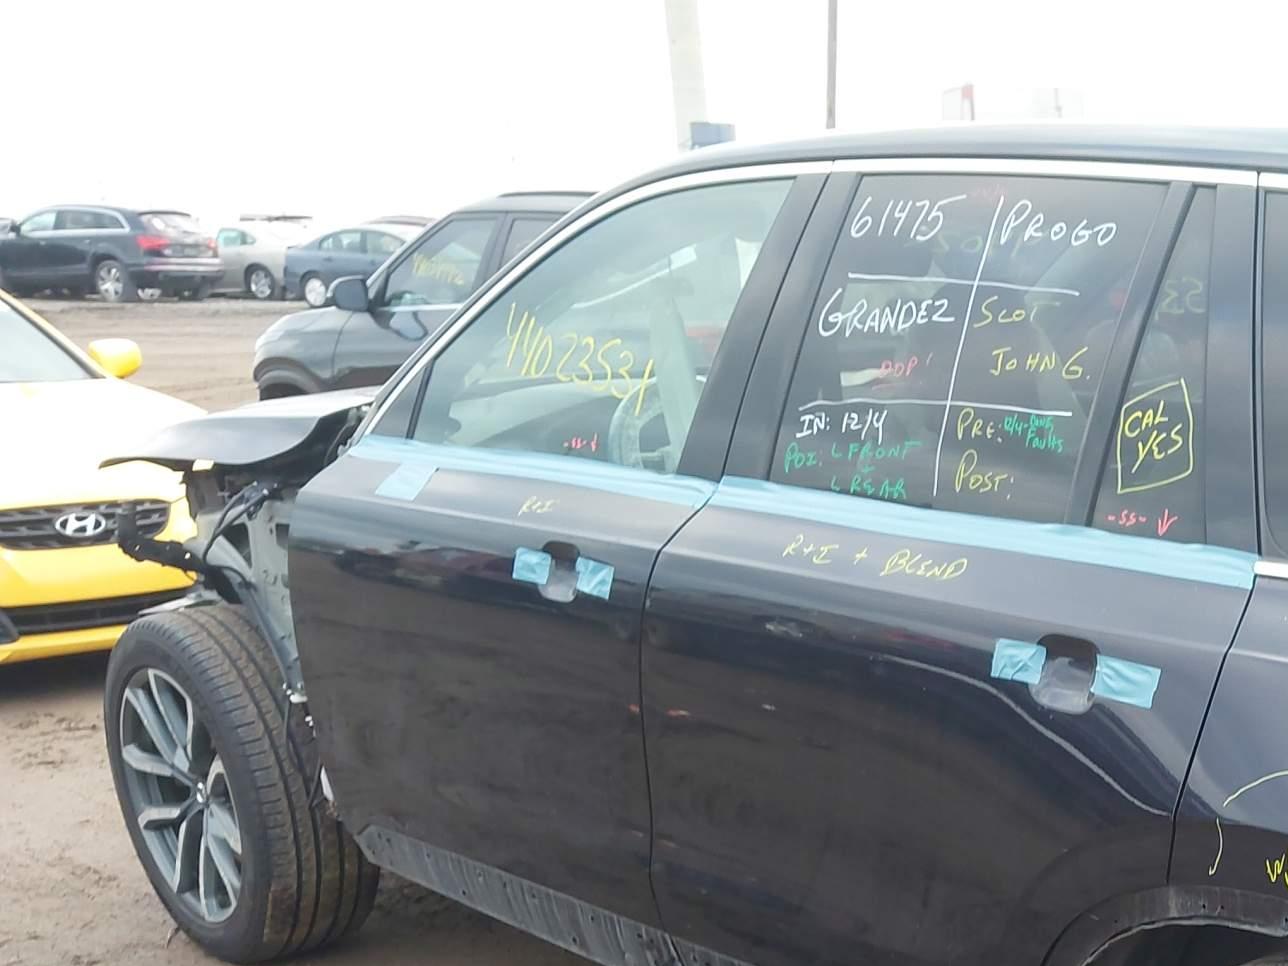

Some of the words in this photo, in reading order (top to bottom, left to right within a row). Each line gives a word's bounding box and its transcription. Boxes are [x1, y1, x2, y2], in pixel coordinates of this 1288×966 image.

[851, 194, 967, 241] 61475
[818, 287, 955, 338] GRANDEZ
[506, 302, 655, 417] 44023531
[795, 411, 831, 439] IN:
[841, 407, 889, 446] 12/4
[1124, 399, 1169, 438] CAL
[1131, 422, 1184, 474] YES
[880, 548, 968, 581] BLEND
